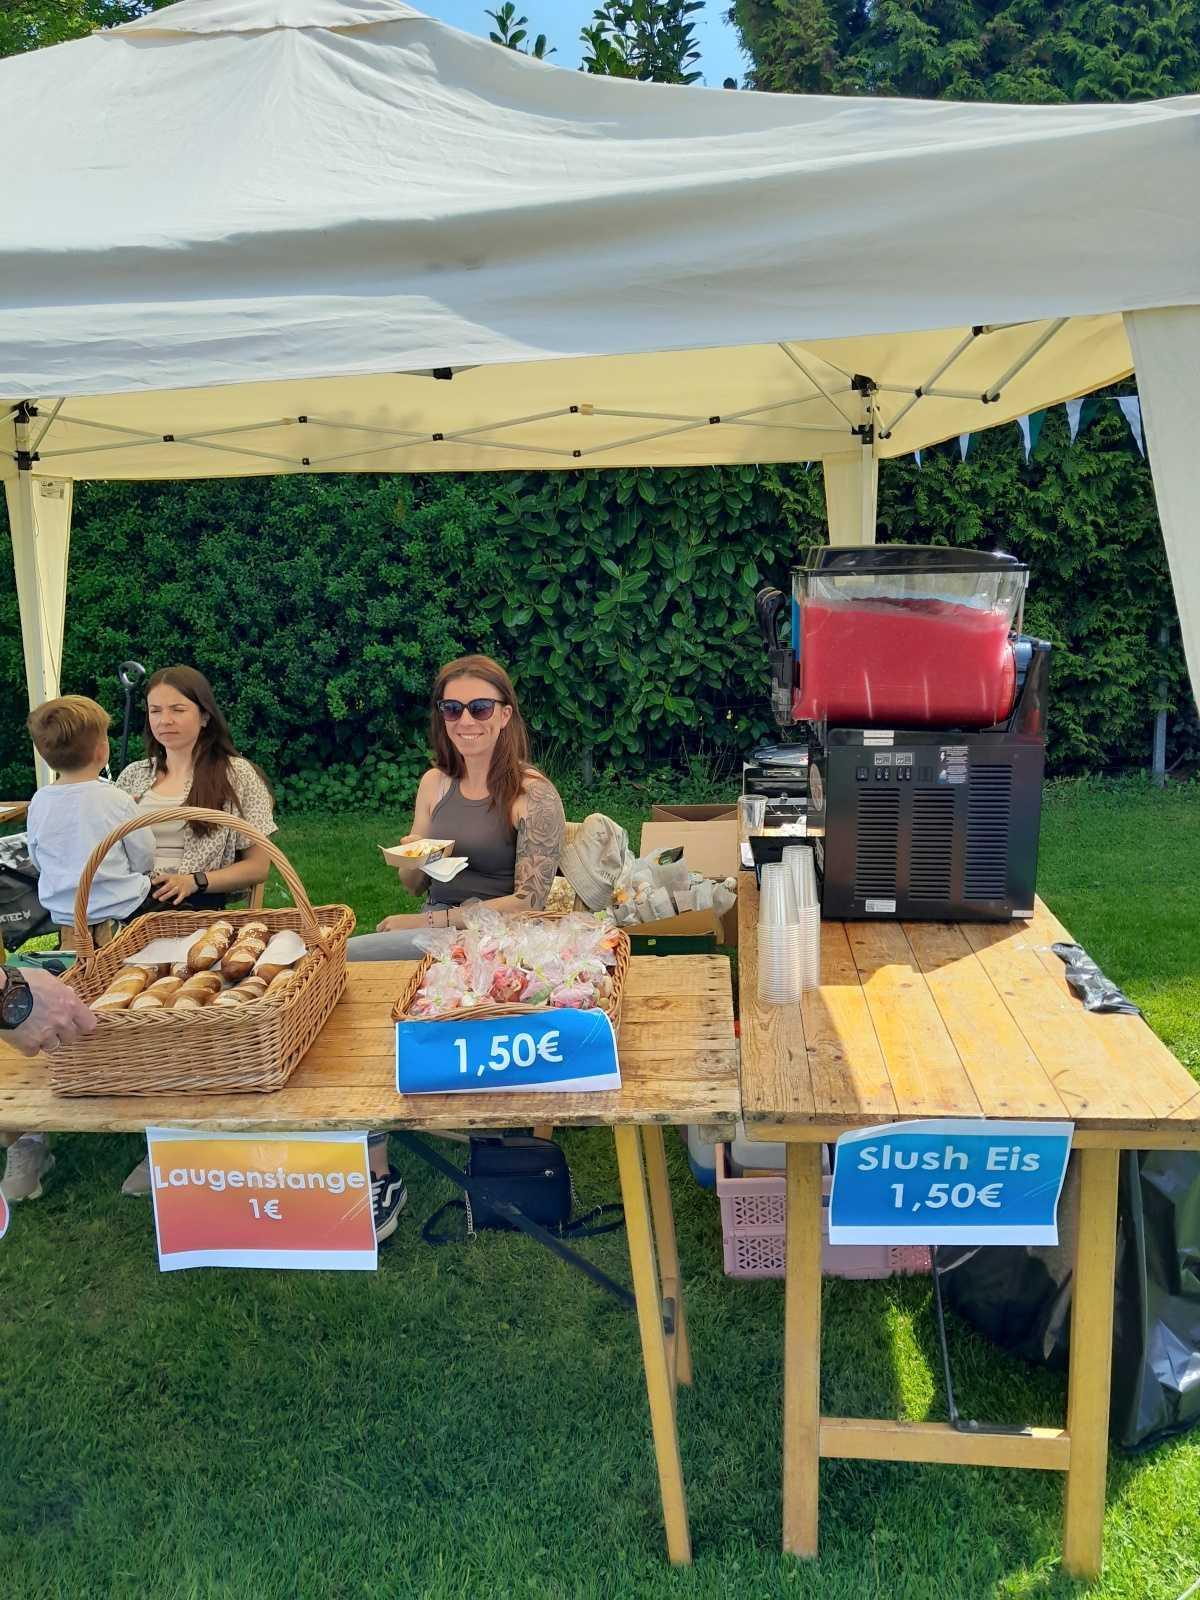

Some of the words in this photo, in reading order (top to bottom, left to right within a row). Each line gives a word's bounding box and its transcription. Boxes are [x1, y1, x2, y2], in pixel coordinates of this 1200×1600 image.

[452, 1030, 563, 1077] 1,50€
[857, 1144, 969, 1171] Slush
[985, 1145, 1041, 1171] Eis
[154, 1165, 365, 1193] Laugenstange
[248, 1198, 282, 1220] 1€
[890, 1183, 1004, 1212] 1,50€
